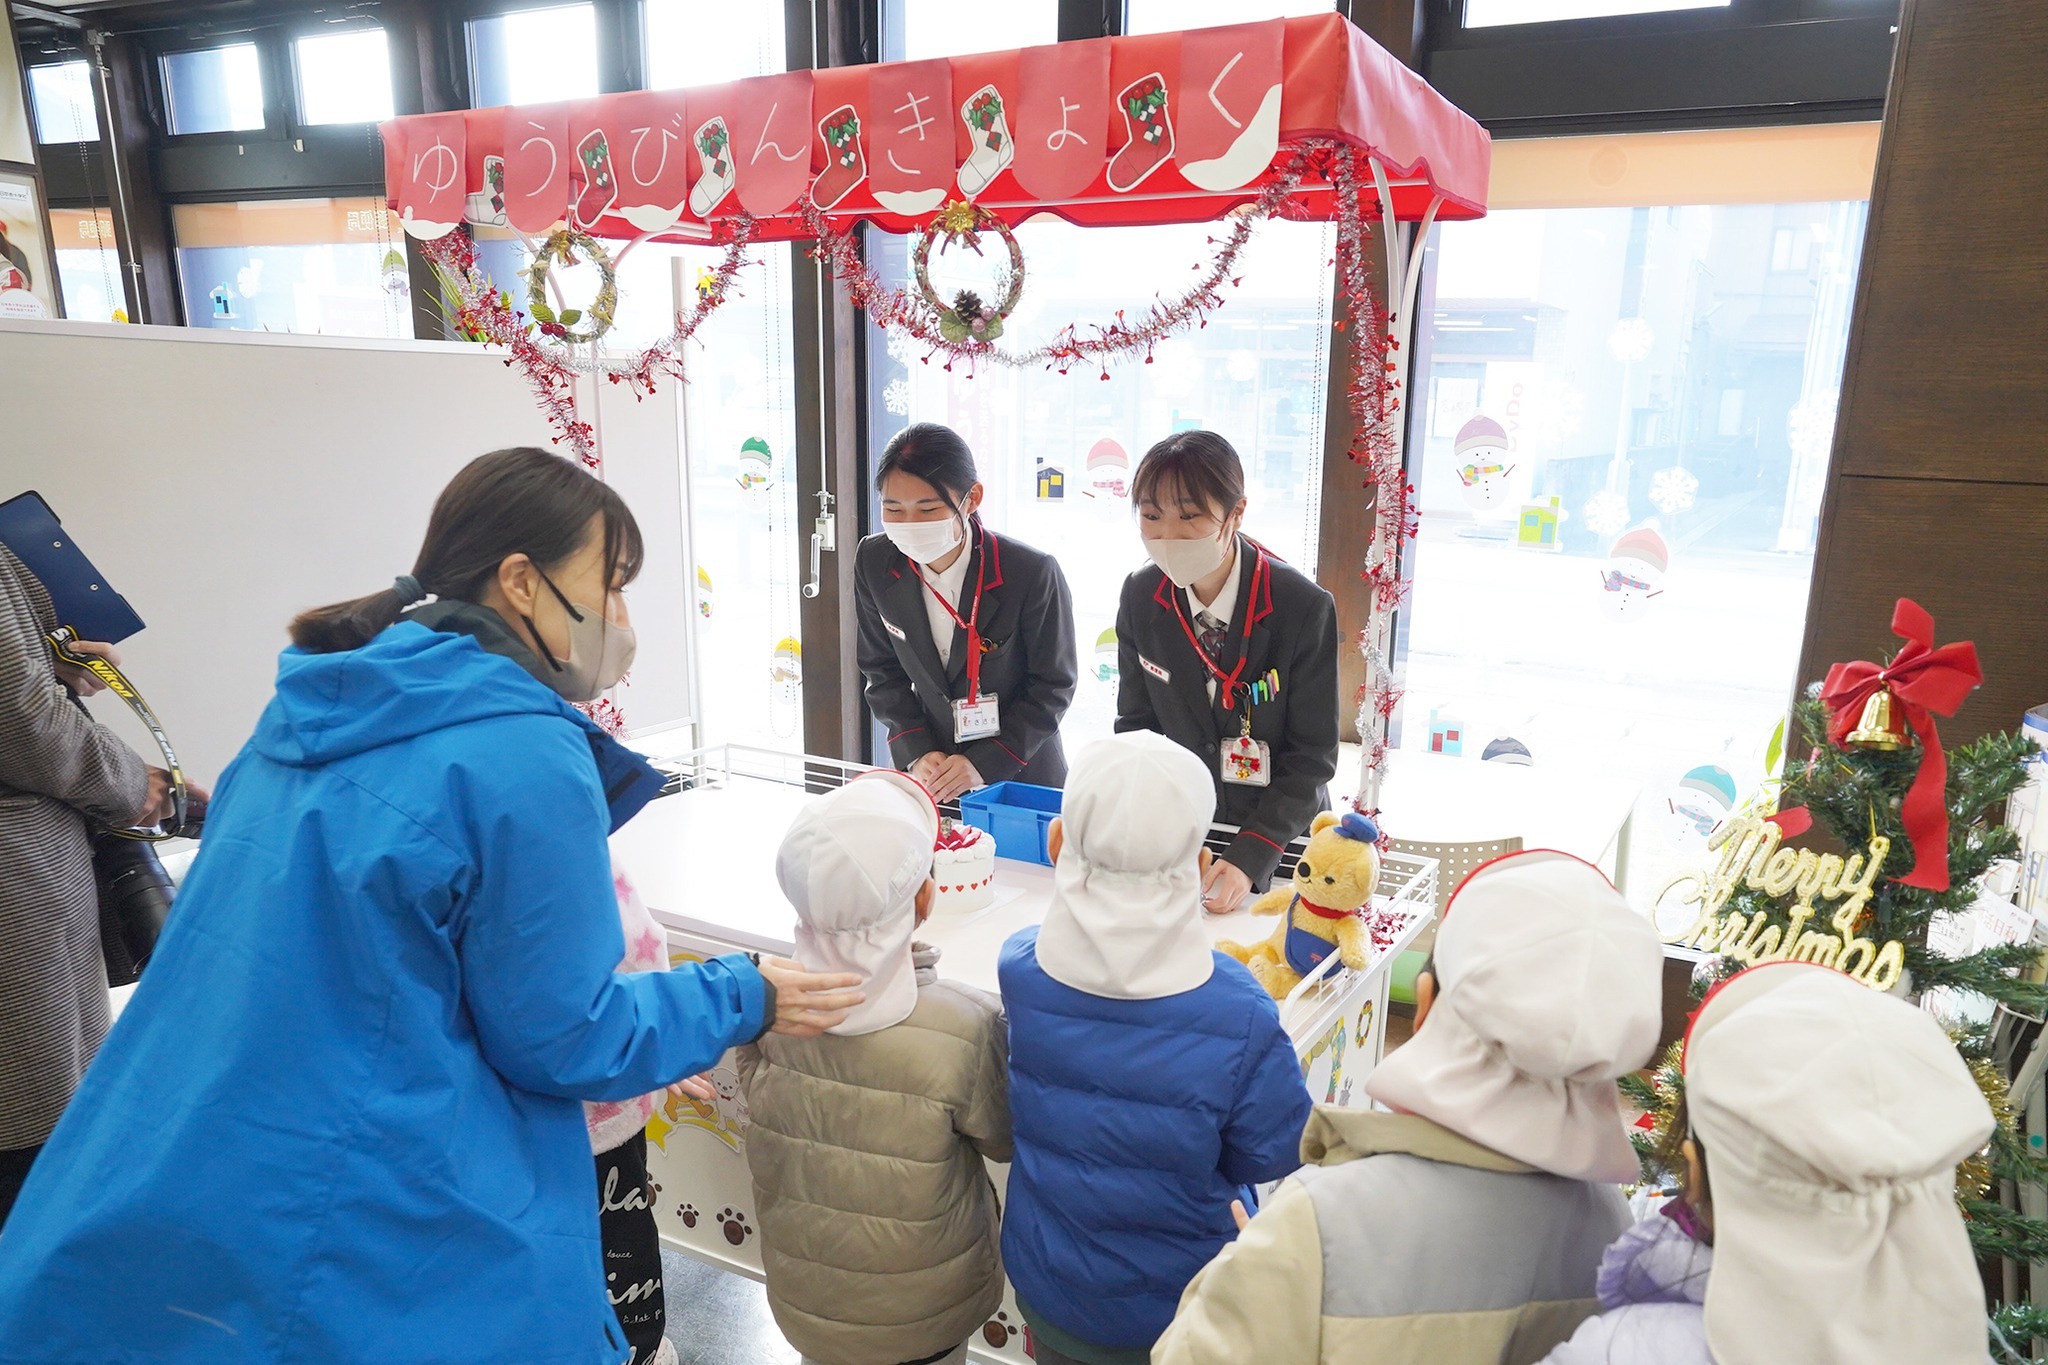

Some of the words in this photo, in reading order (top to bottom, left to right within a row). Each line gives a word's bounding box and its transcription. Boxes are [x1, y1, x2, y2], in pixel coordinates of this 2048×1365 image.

[87, 659, 134, 698] Nikon
[1653, 870, 1904, 991] Christmas
[1707, 816, 1890, 933] Merry
